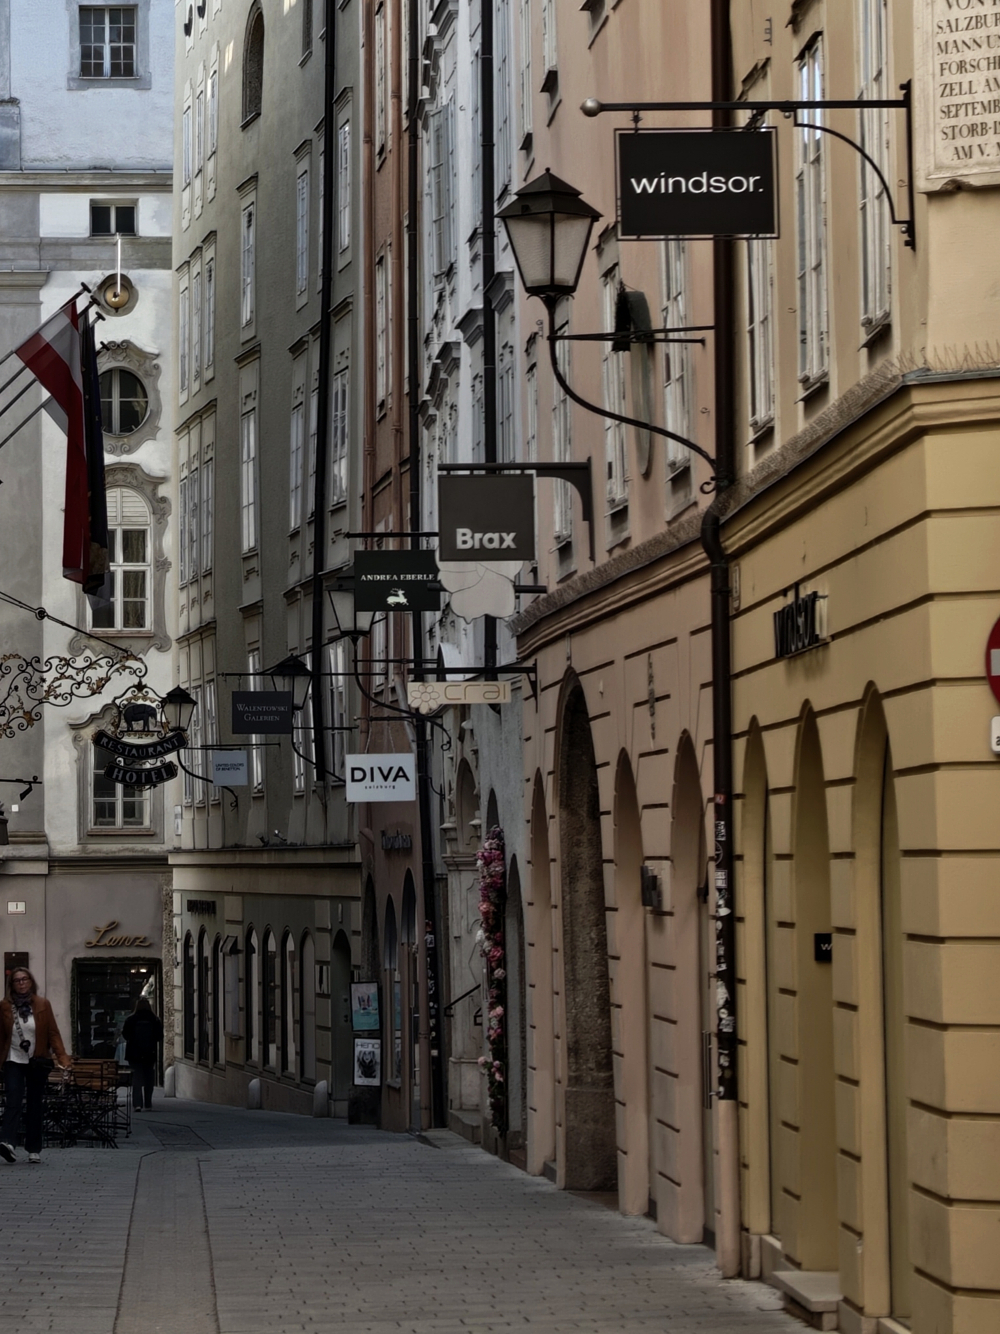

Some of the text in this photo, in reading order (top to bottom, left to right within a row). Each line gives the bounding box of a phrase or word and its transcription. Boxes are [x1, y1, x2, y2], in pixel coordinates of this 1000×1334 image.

[937, 36, 983, 55] MANN
[940, 80, 978, 98] ZELL
[951, 145, 973, 161] AM
[631, 172, 764, 194] windsor.
[456, 528, 517, 550] Brax
[100, 736, 179, 757] RESTAURANT
[112, 767, 171, 783] HOTEL
[351, 766, 410, 783] DIVA
[85, 921, 154, 948] Lanz
